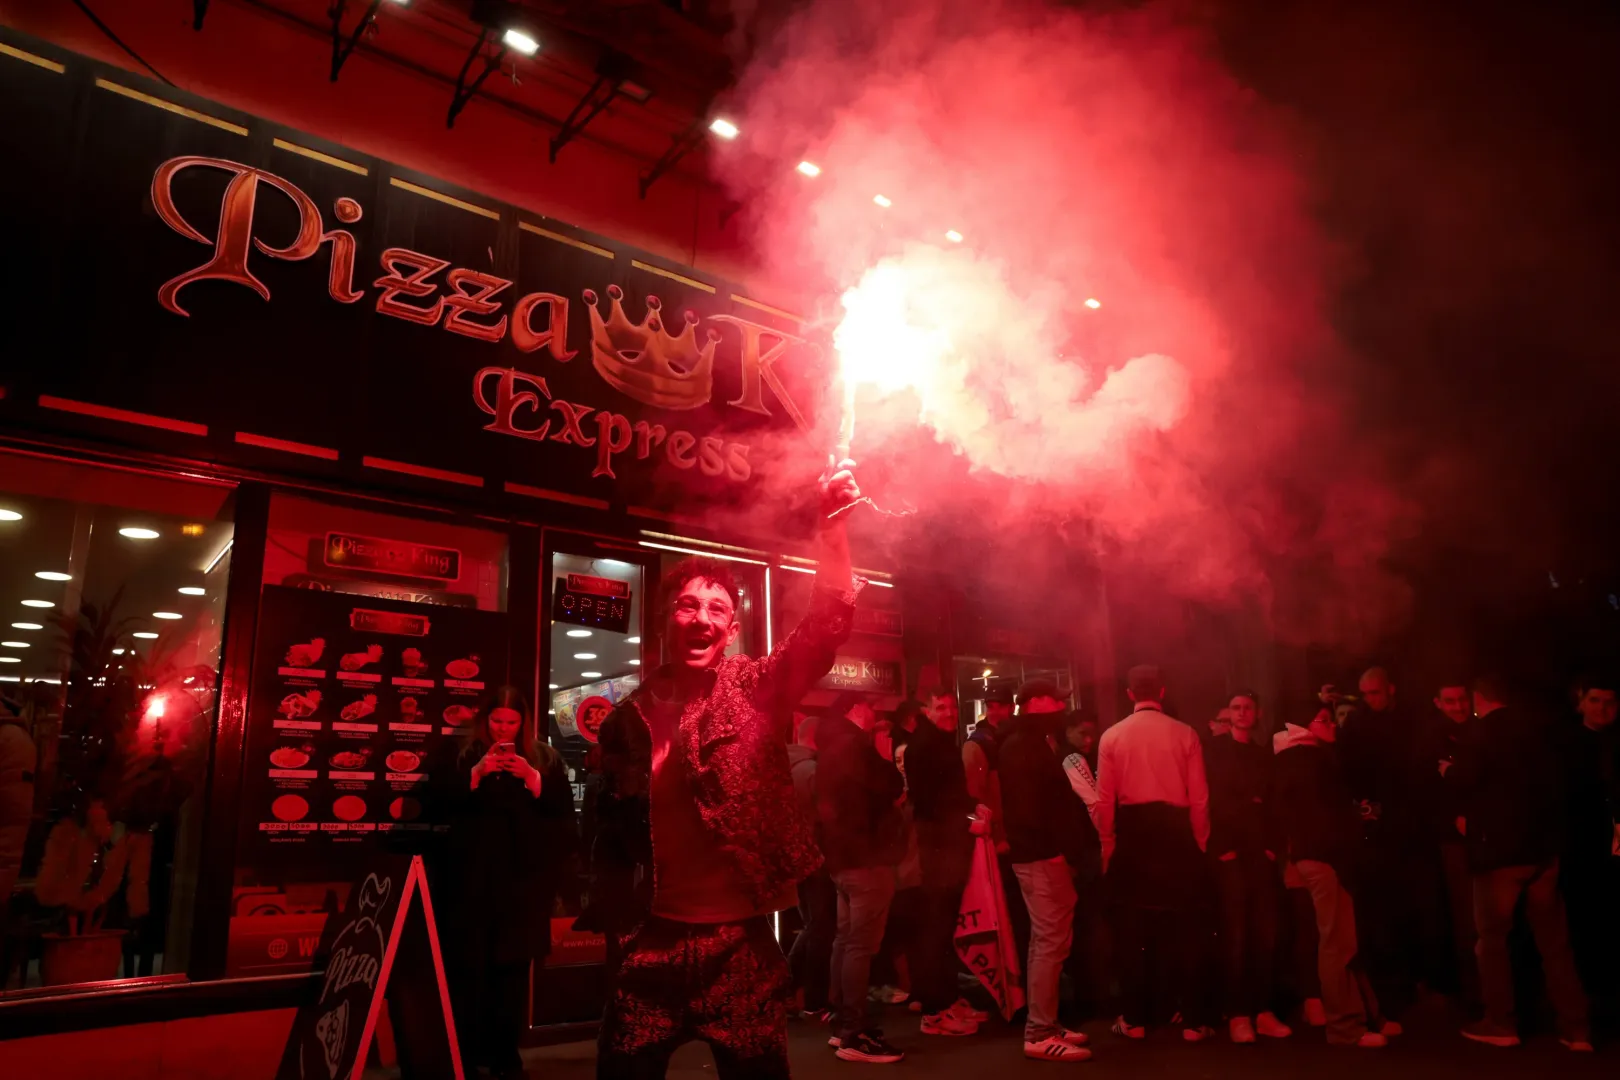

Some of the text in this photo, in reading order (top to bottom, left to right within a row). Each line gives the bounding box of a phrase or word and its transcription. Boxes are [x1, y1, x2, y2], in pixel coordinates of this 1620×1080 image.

[151, 155, 579, 363] Pizza
[472, 366, 751, 481] Express
[561, 594, 624, 620] OPEN
[319, 945, 378, 1005] Pizza
